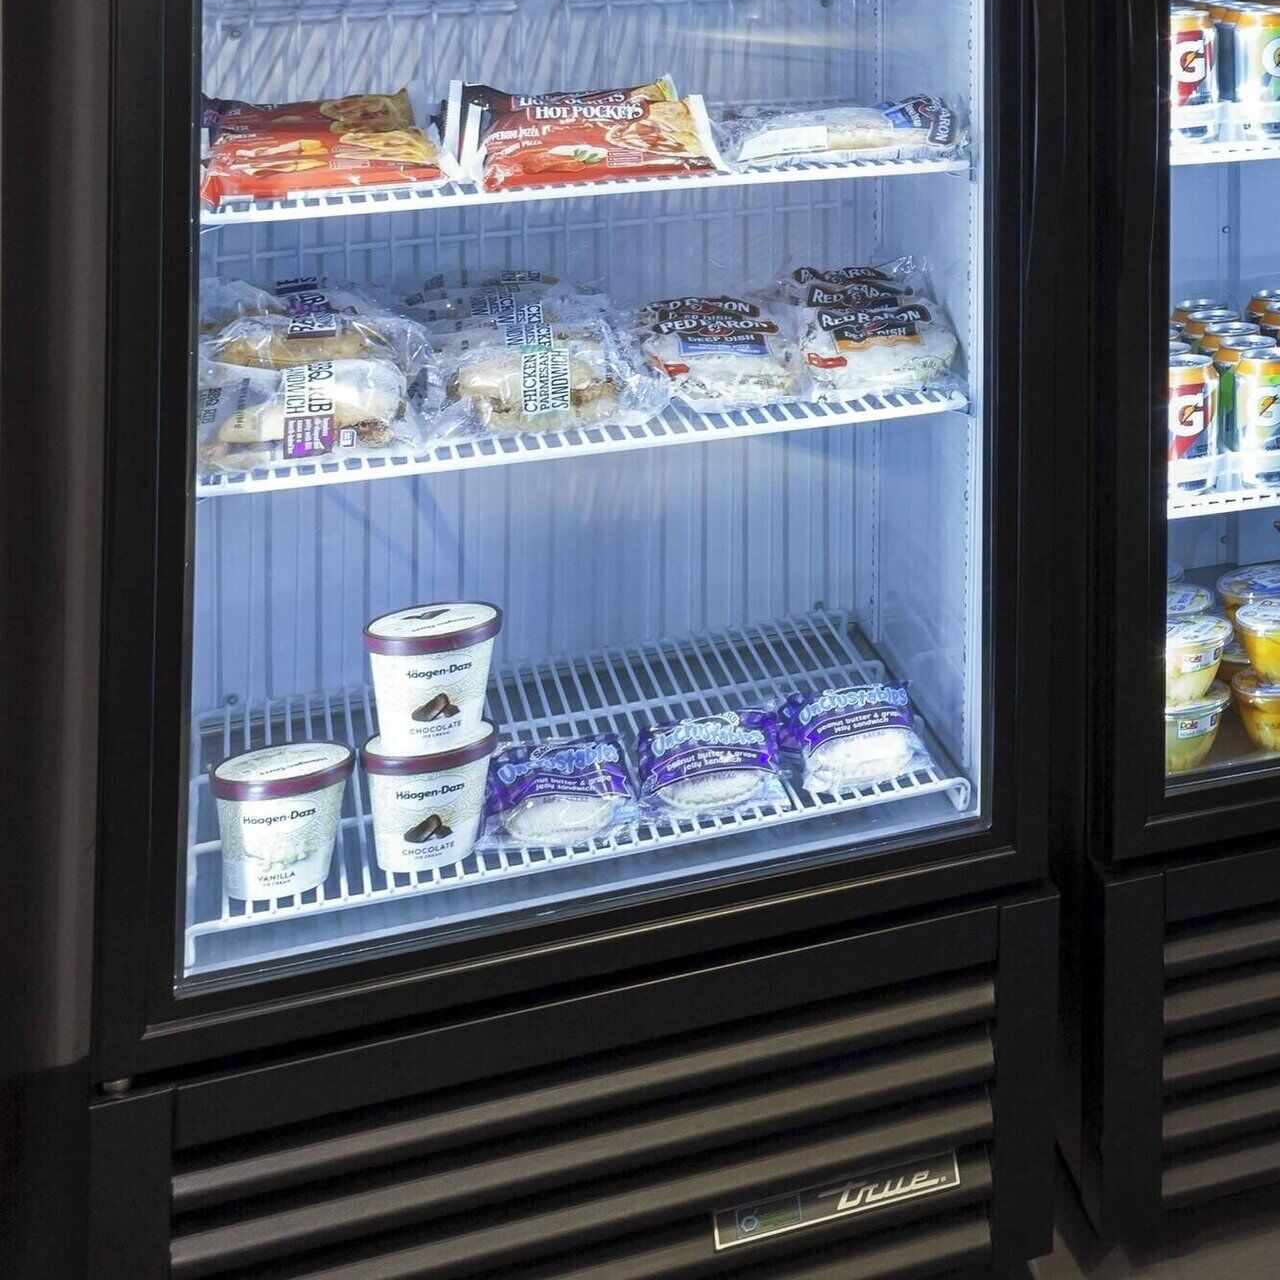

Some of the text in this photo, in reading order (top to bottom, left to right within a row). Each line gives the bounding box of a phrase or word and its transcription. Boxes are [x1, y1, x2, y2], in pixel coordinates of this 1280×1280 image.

[536, 107, 569, 119] HOT
[523, 355, 538, 413] CHICKEN
[539, 351, 549, 413] PARMESAN
[551, 350, 569, 409] SANDWICH
[410, 720, 462, 736] CHOCOLATE
[853, 718, 889, 727] sandwich
[1180, 721, 1198, 730] Dole
[402, 842, 455, 856] CHOCOLATE
[258, 871, 296, 882] VANILLA
